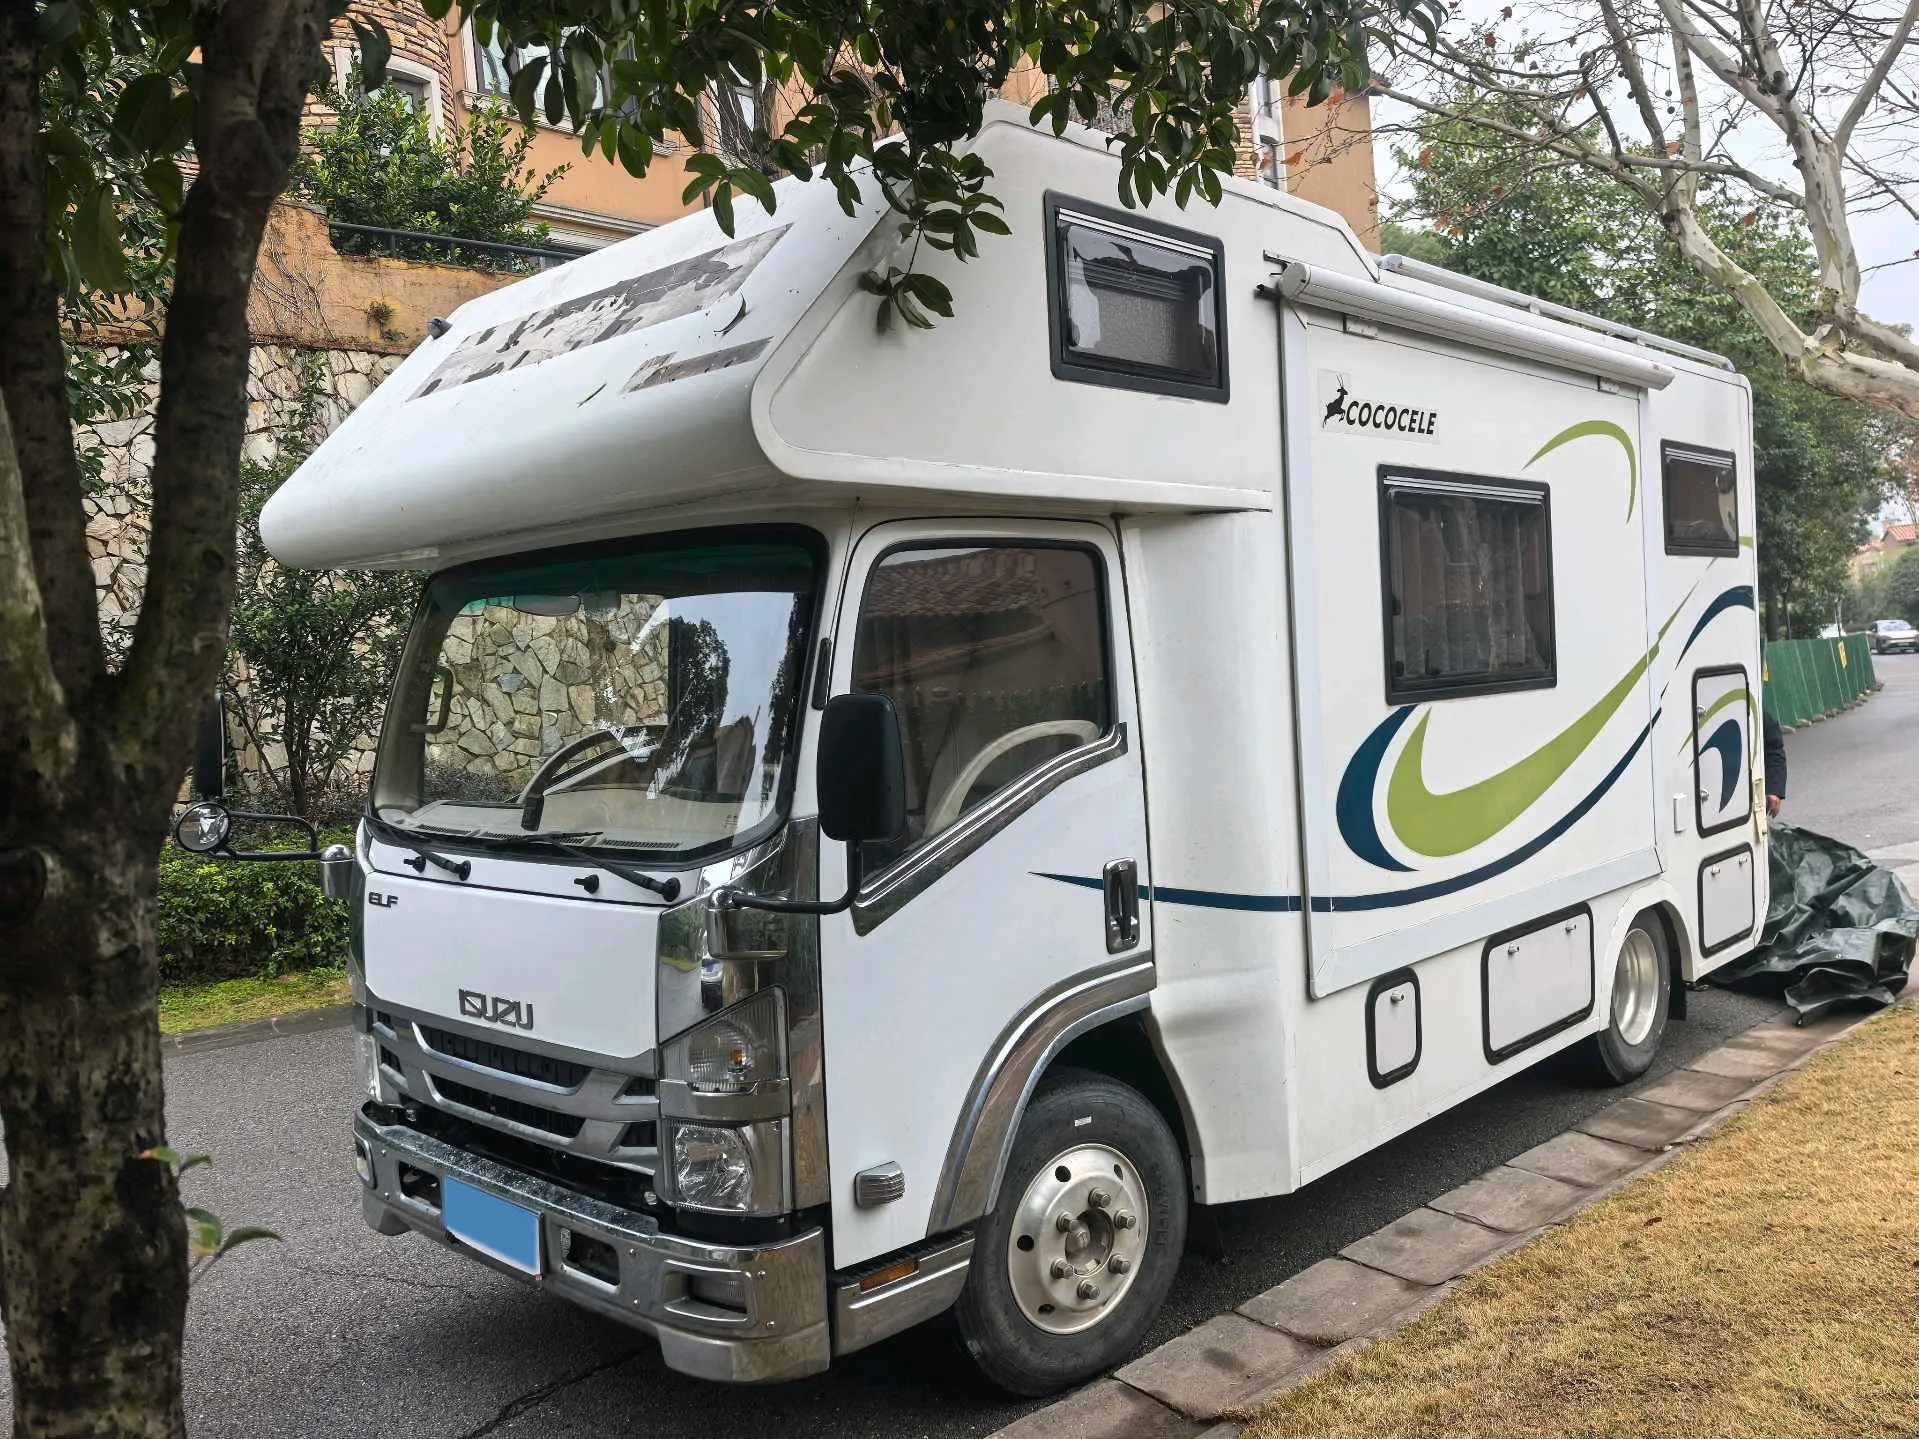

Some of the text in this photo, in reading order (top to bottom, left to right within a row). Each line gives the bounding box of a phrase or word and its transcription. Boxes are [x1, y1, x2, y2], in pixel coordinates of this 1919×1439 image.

[1346, 400, 1437, 435] COCOCELE
[368, 891, 398, 908] ELF
[459, 988, 533, 1031] ISUZU
